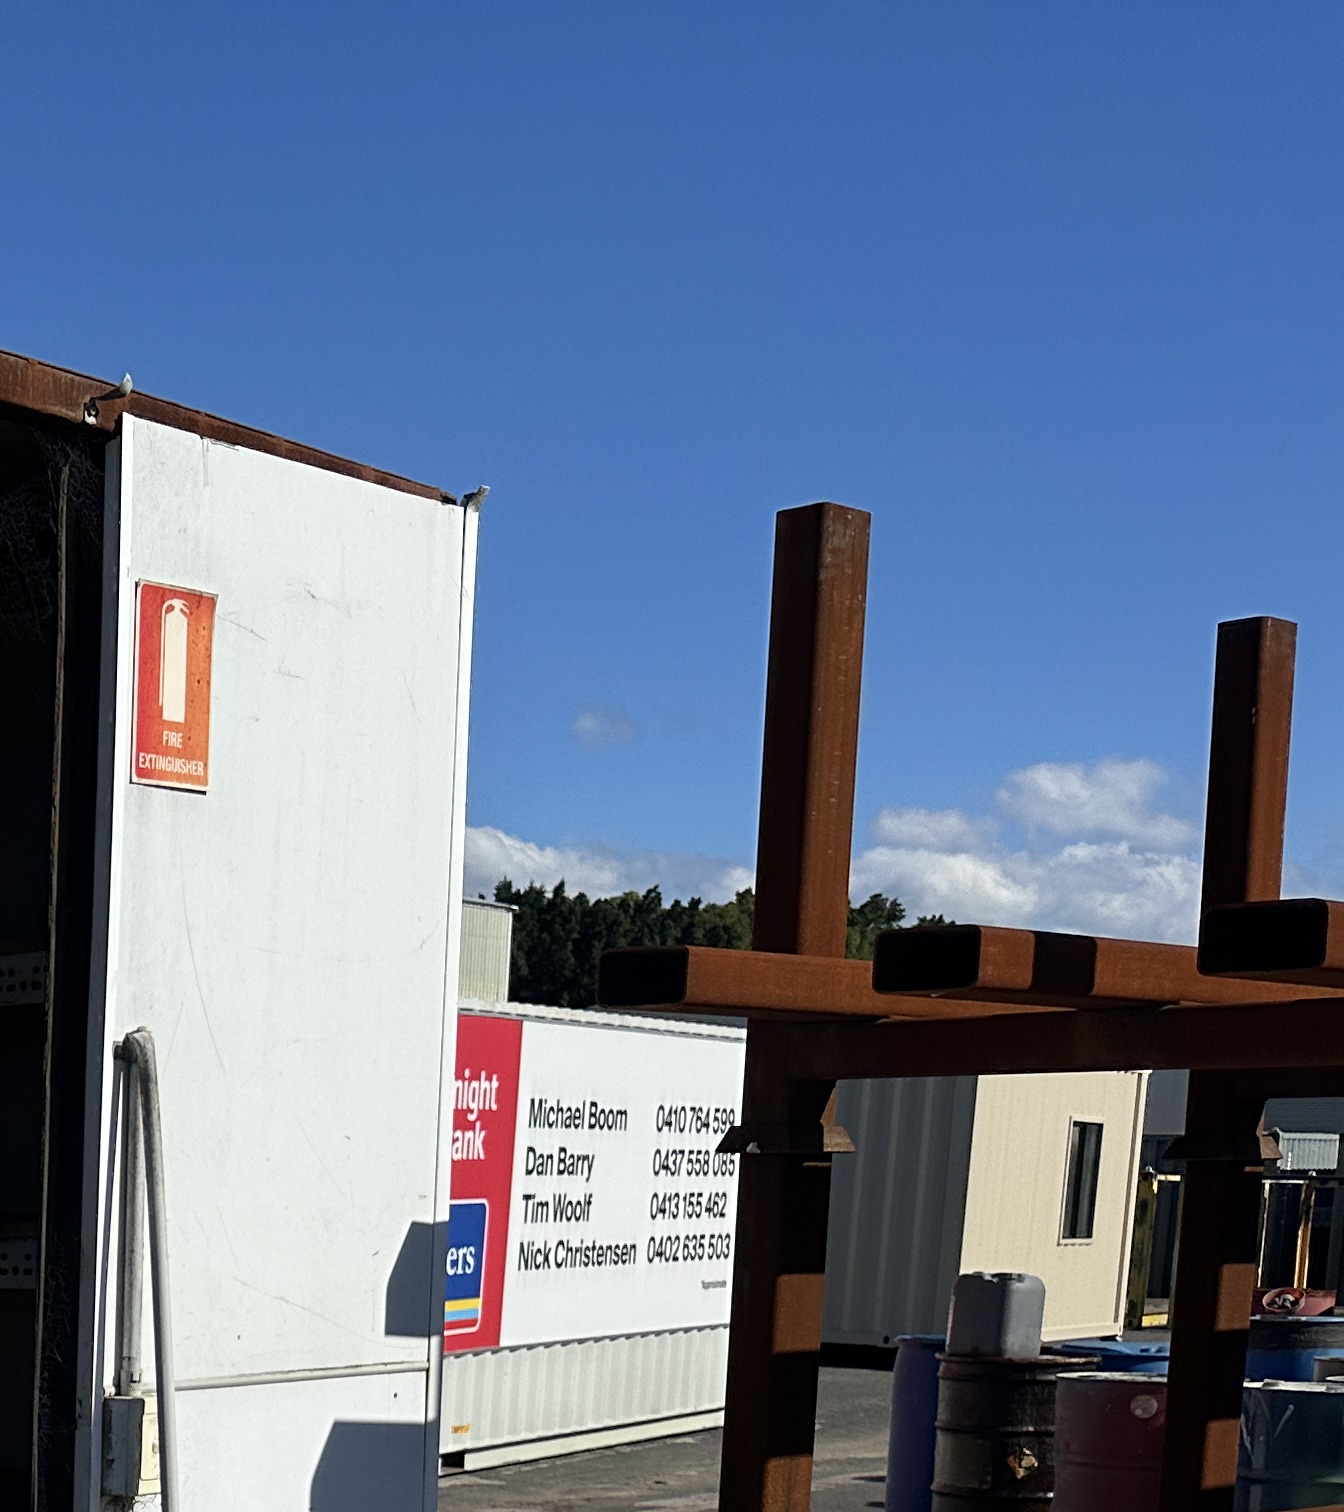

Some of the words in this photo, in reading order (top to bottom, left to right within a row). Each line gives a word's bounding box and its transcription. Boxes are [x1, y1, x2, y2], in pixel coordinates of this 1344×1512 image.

[162, 730, 183, 749] FIRE
[137, 752, 204, 776] EXTINGUISHER
[453, 1068, 499, 1121] night
[528, 1097, 586, 1130] Michael
[588, 1100, 628, 1132] Boom
[656, 1104, 687, 1133] 0410
[688, 1106, 711, 1134] 764
[452, 1121, 486, 1161] ank
[525, 1146, 554, 1176] Dan
[556, 1146, 595, 1183] Barry
[653, 1148, 685, 1176] 0437
[686, 1149, 710, 1177] 558
[712, 1152, 736, 1177] 085
[522, 1193, 549, 1224] Tim
[552, 1193, 593, 1223] Woolf
[650, 1192, 680, 1220] 0413
[682, 1192, 703, 1219] 155
[704, 1192, 727, 1219] 462
[446, 1245, 475, 1276] ers
[517, 1240, 551, 1271] Nick
[554, 1239, 637, 1269] Christensen
[647, 1235, 680, 1264] 0402
[682, 1233, 706, 1262] 635
[707, 1232, 731, 1260] 503
